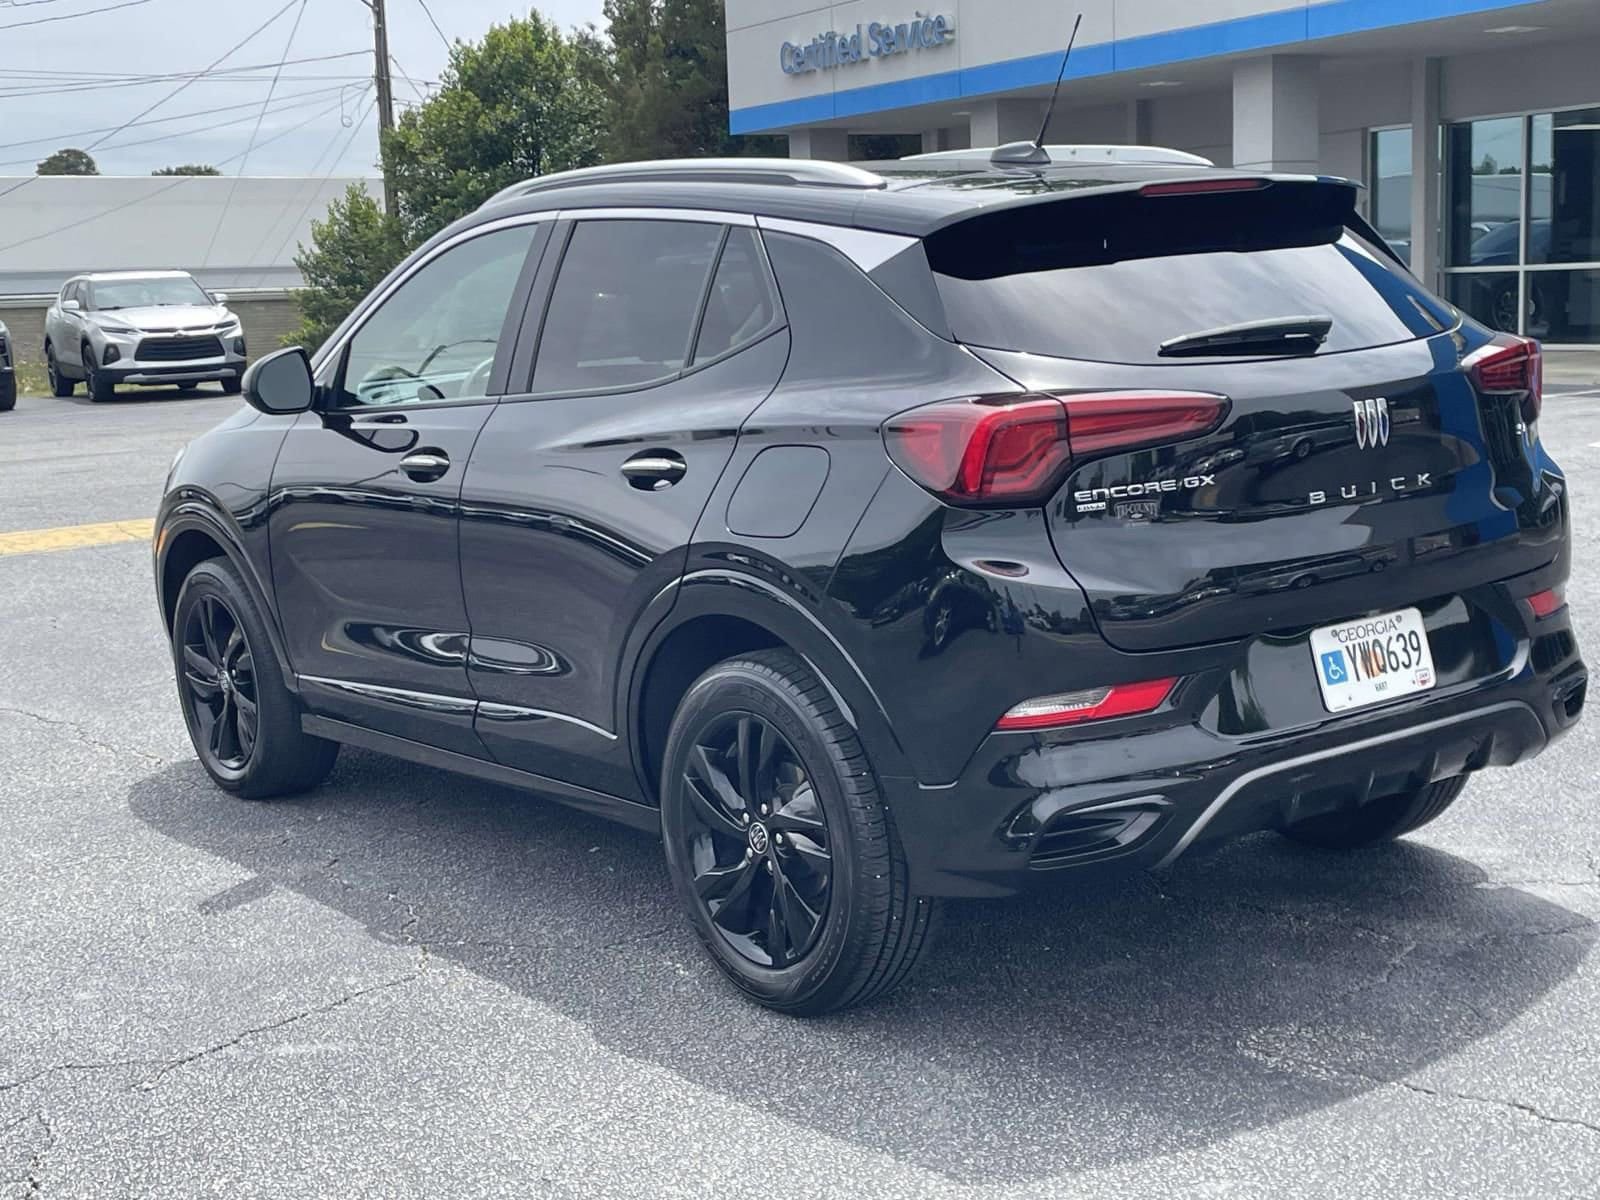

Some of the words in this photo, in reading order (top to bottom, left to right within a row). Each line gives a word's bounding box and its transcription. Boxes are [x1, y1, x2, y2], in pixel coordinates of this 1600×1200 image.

[780, 24, 862, 74] Certified
[868, 11, 952, 57] Service
[1074, 479, 1177, 502] ENCORE
[1184, 474, 1216, 488] GX
[1309, 472, 1432, 504] BUICK
[1338, 618, 1398, 643] GEORGIA
[1345, 630, 1421, 682] YWQ639
